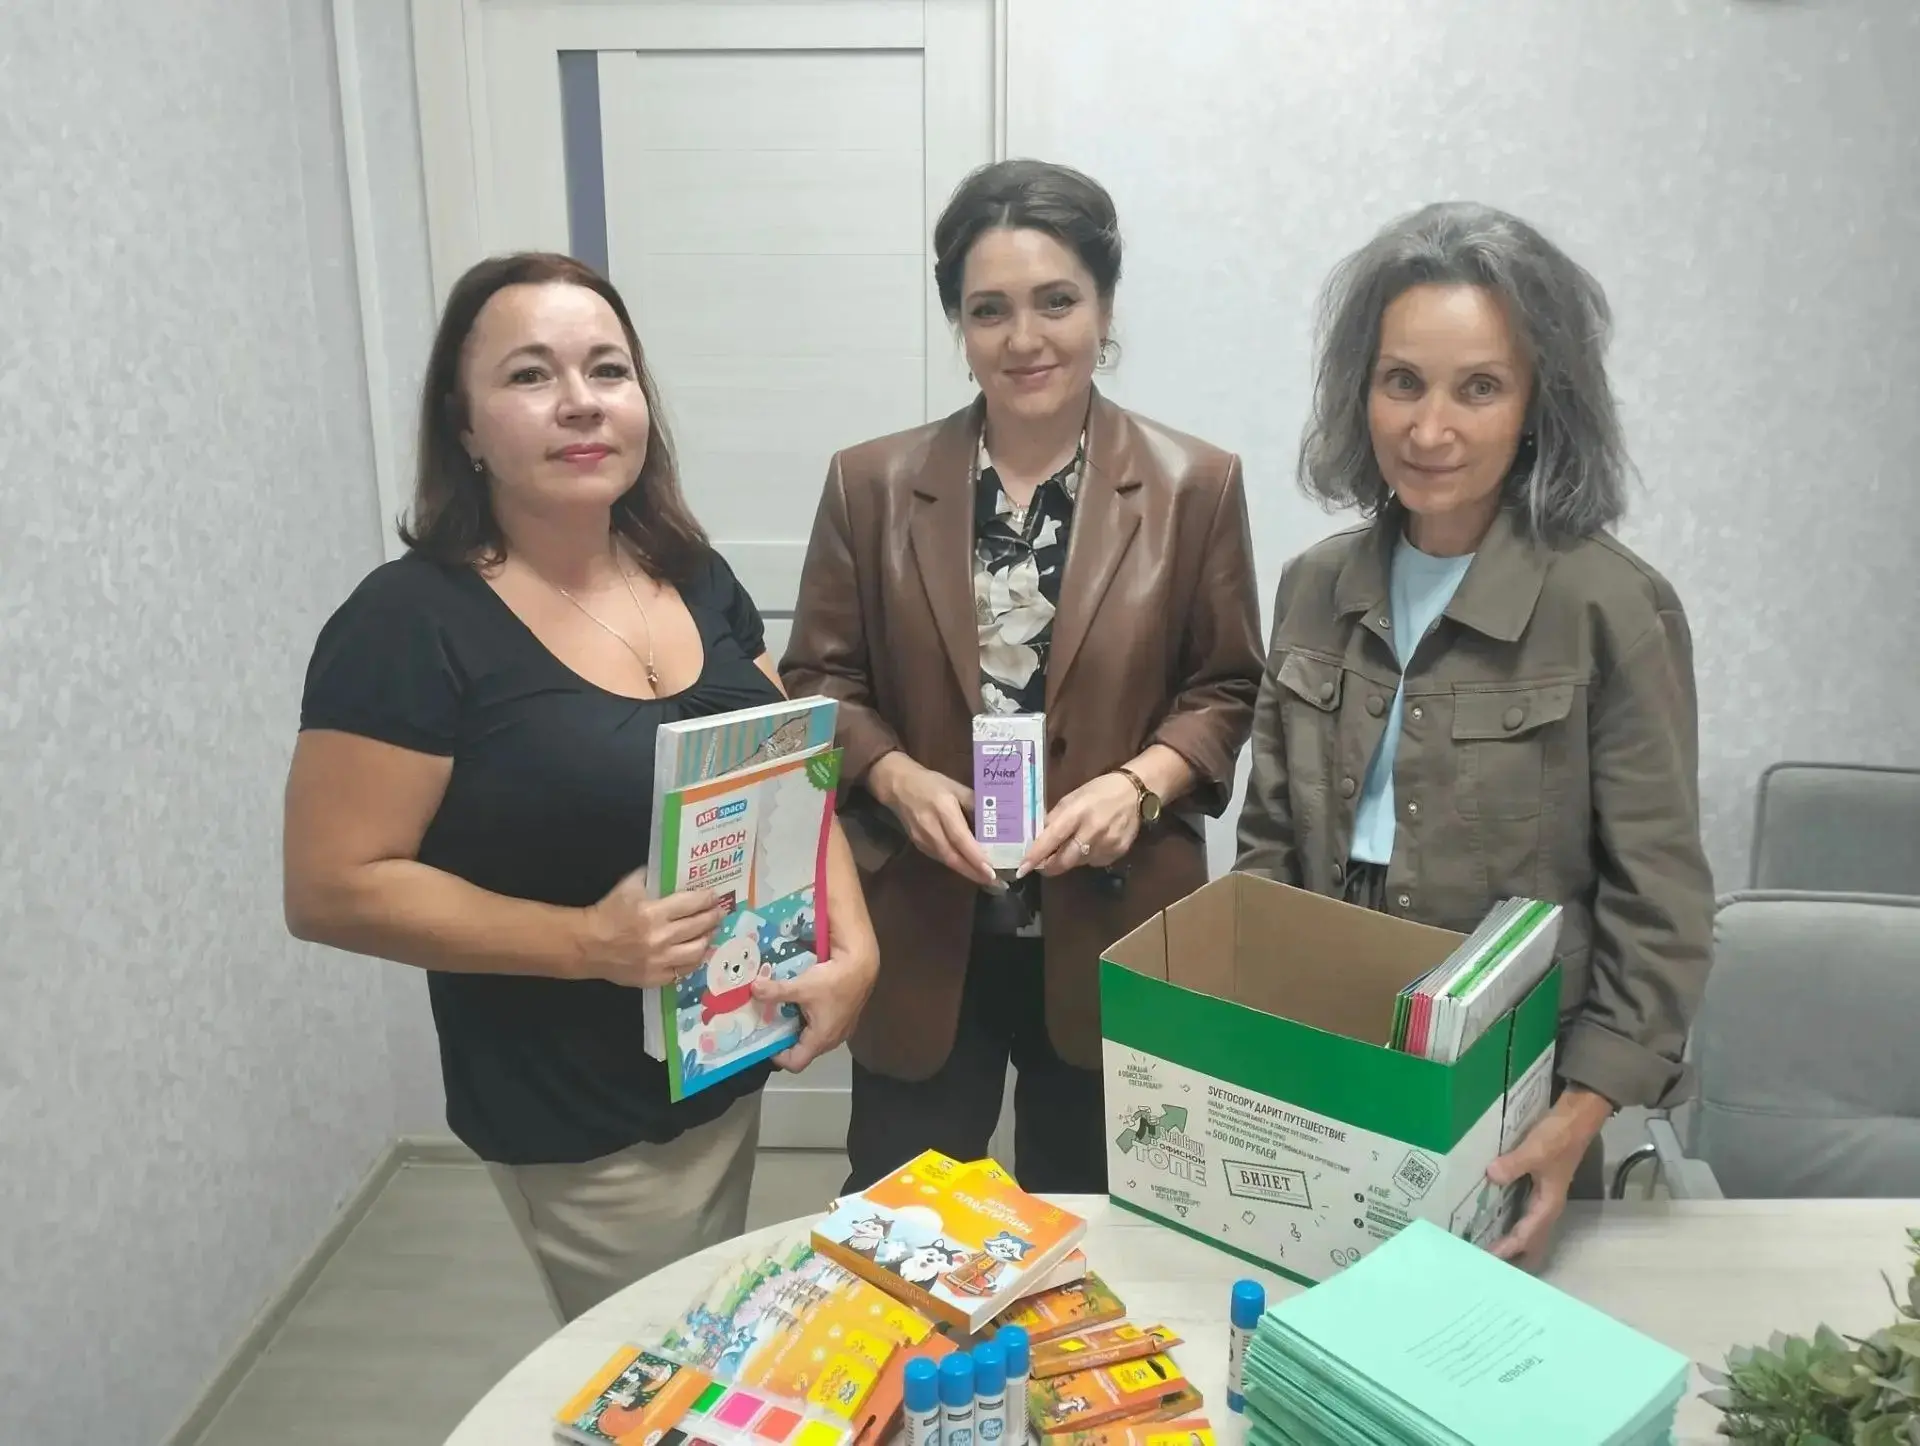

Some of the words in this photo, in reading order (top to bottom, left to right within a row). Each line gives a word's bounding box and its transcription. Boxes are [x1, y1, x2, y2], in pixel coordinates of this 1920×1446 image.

[984, 769, 1015, 780] Ручка
[697, 808, 718, 826] ART
[719, 802, 746, 818] space
[690, 830, 746, 859] КАРТОН
[688, 846, 744, 880] БЕЛЫЙ
[1207, 1085, 1255, 1109] SVETOCOPY
[1255, 1102, 1283, 1120] ДАРИТ
[1283, 1111, 1348, 1143] ПУТЕШЕСТВИЕ
[1212, 1129, 1227, 1142] 500
[1229, 1135, 1245, 1148] 000
[1245, 1141, 1277, 1160] РУБЛЕЙ
[1240, 1170, 1291, 1192] БИЛЕТ
